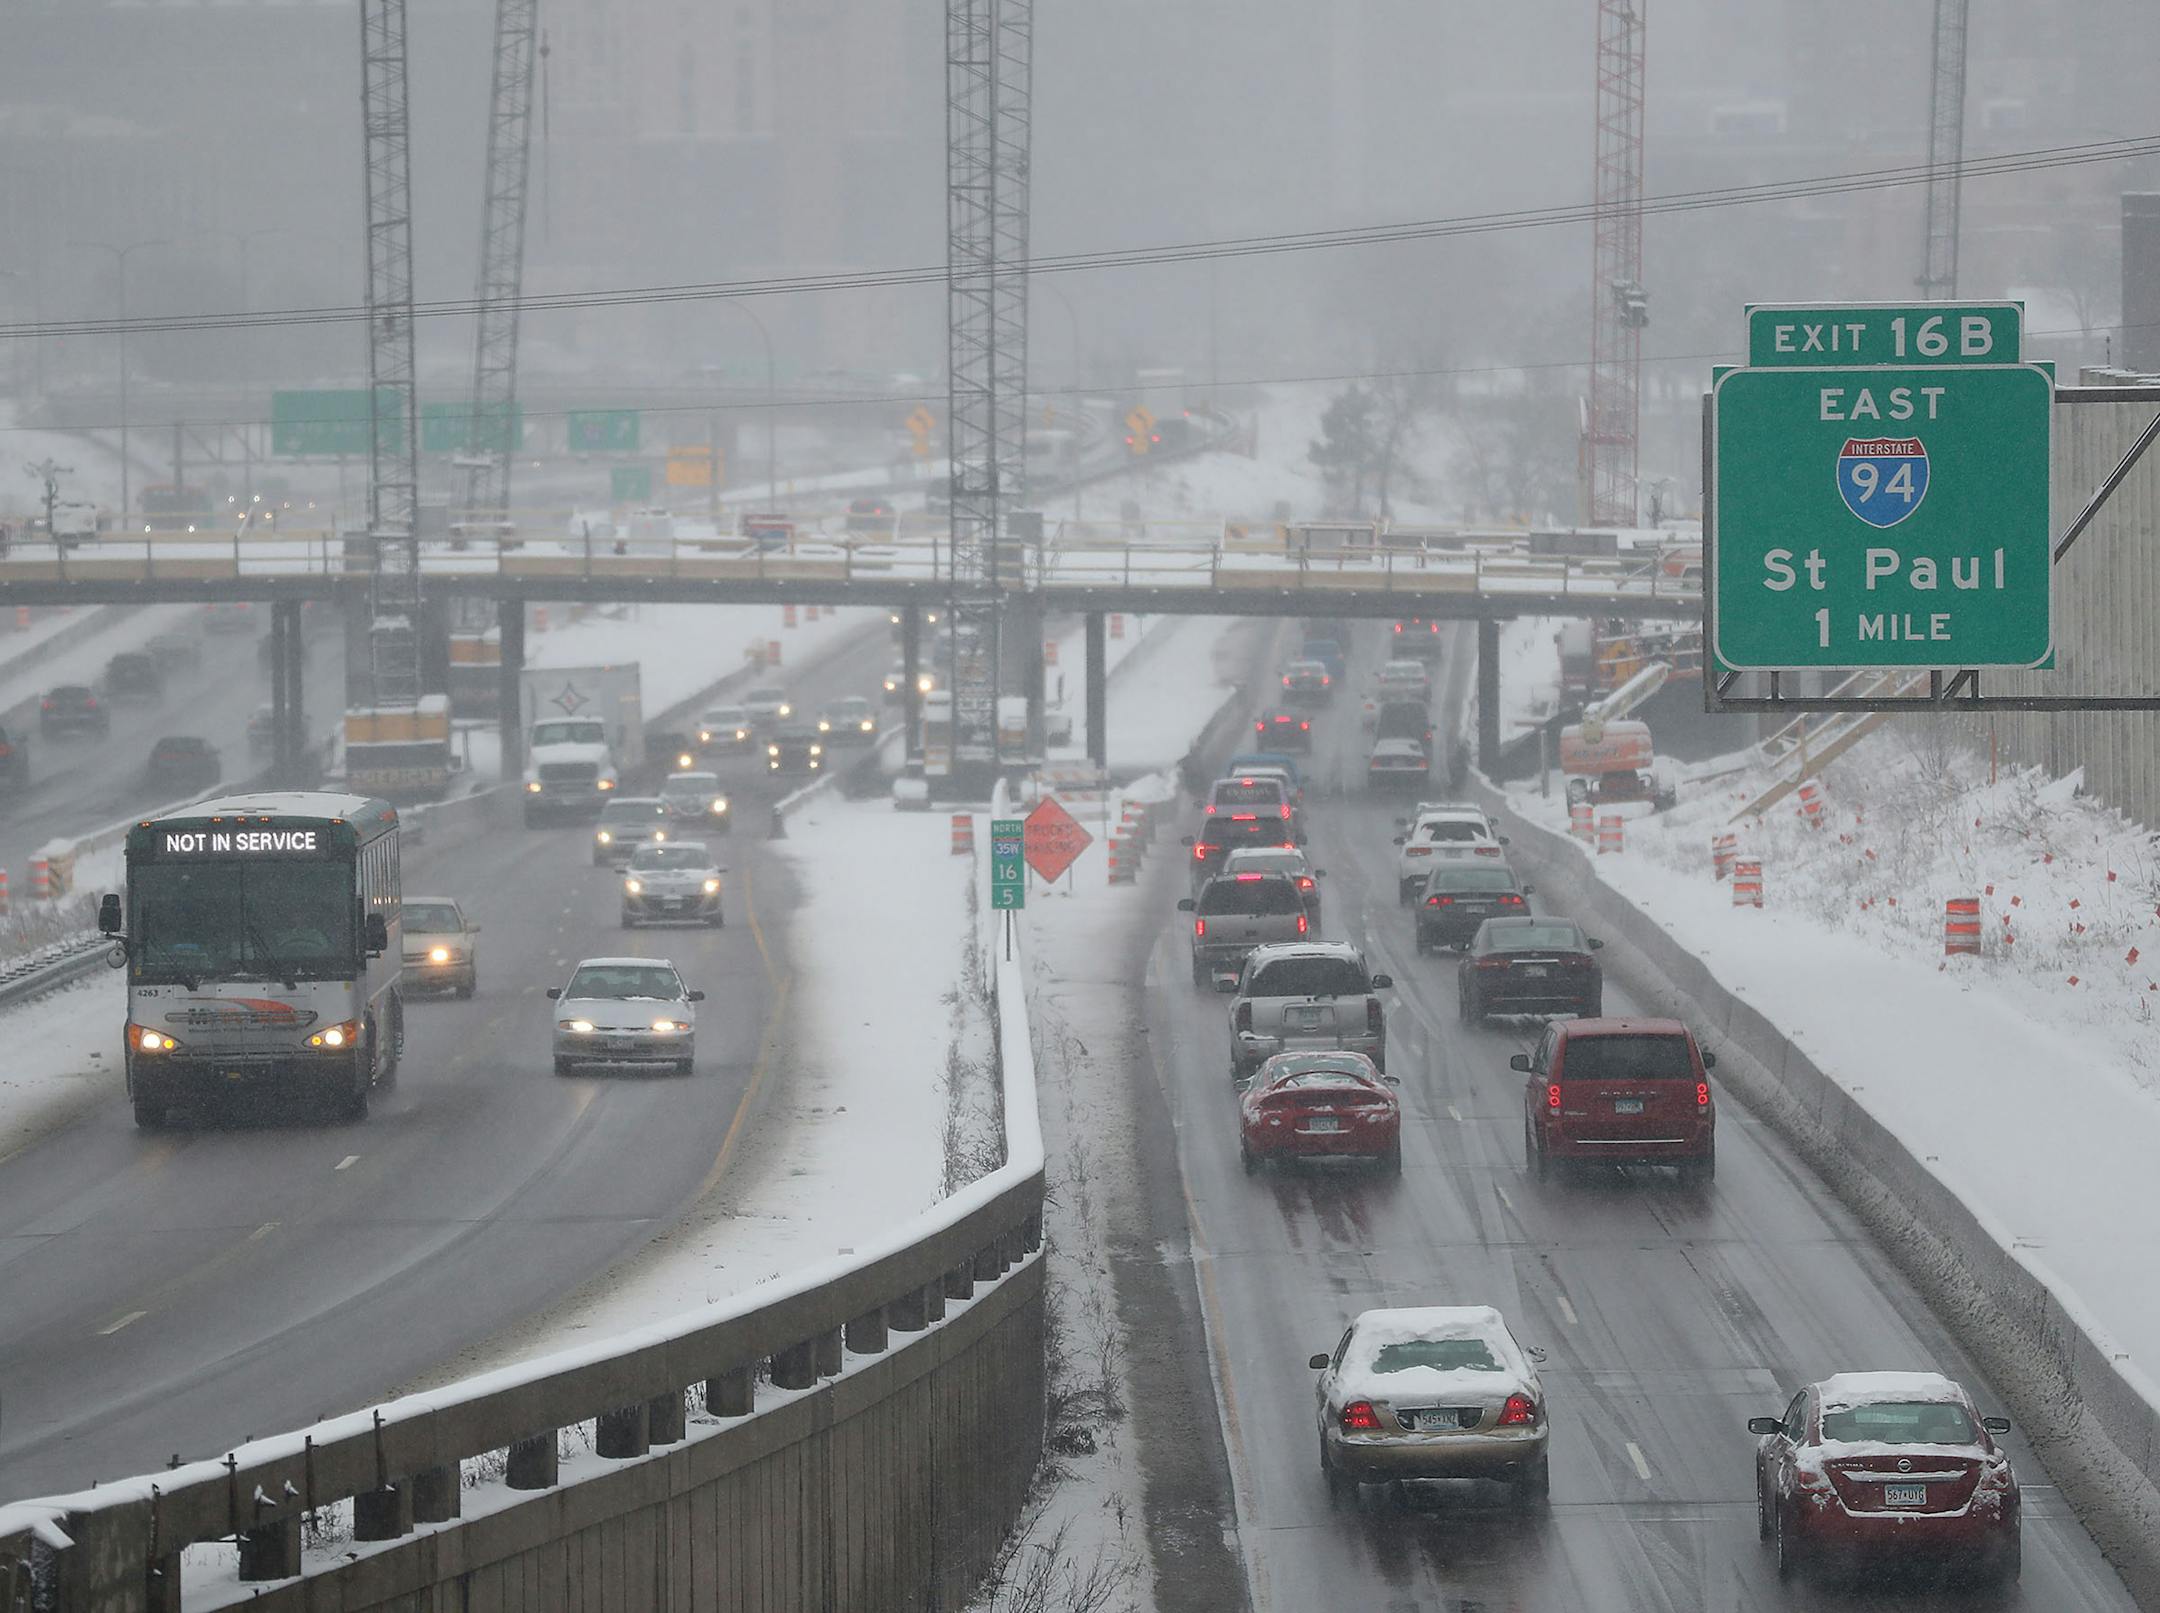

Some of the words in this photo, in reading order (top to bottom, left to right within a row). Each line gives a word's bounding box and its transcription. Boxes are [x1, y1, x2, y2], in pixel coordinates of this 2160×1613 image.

[1774, 324, 1866, 352] EXIT
[1890, 315, 1994, 357] 16B
[1820, 387, 1946, 421] EAST
[1851, 442, 1915, 456] INTERSTATE
[1850, 462, 1916, 504] 94
[1762, 548, 1827, 591] St
[1865, 547, 2006, 591] Paul
[1814, 607, 1831, 648] 1
[1858, 613, 1952, 641] MILE
[993, 823, 1022, 833] NORTH
[166, 833, 207, 852] NOT
[212, 833, 231, 851] IN
[236, 831, 316, 851] SERVICE
[996, 843, 1019, 855] 35W
[999, 864, 1017, 880] 16
[136, 989, 160, 998] 4263
